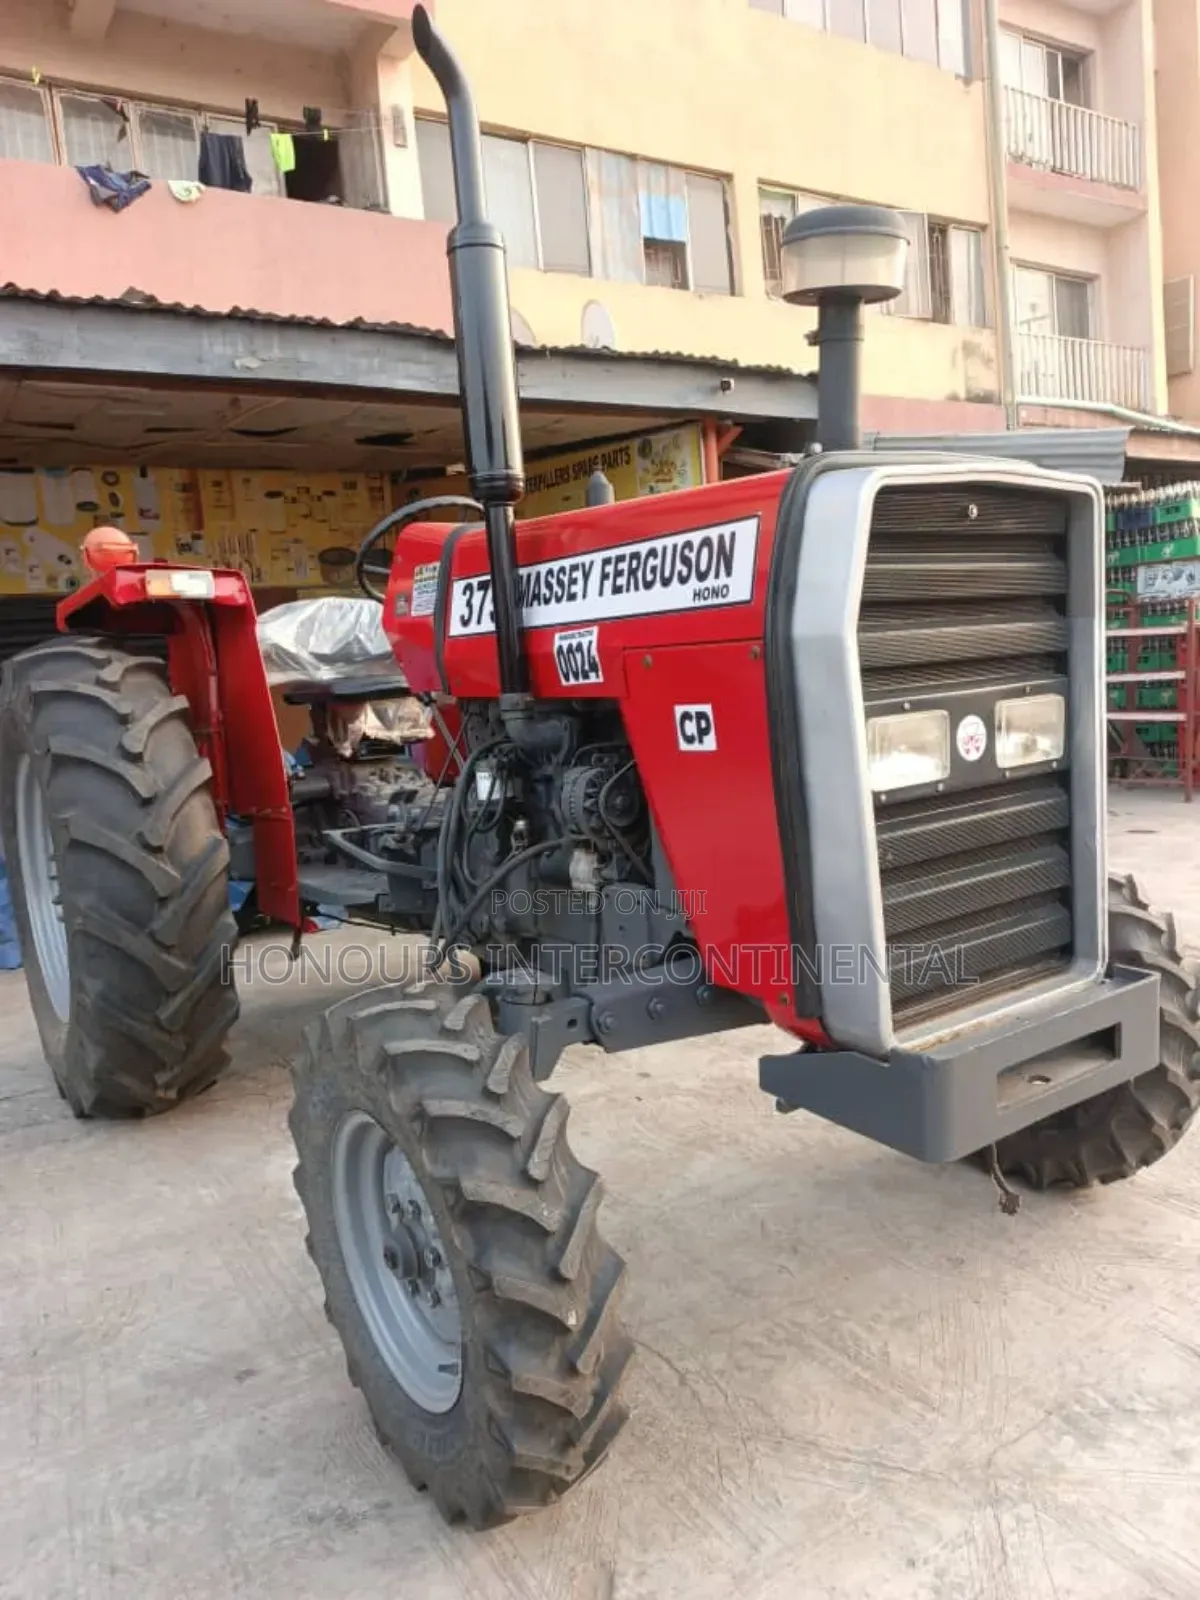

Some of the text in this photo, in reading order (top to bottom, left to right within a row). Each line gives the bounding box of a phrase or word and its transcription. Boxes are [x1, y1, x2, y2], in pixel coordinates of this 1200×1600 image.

[601, 446, 631, 470] PARTS
[460, 579, 495, 628] 37
[515, 560, 594, 608] MASSEY
[598, 531, 736, 598] FERGUSON
[692, 584, 730, 603] HONO
[556, 639, 600, 683] 0024
[679, 711, 712, 745] CP
